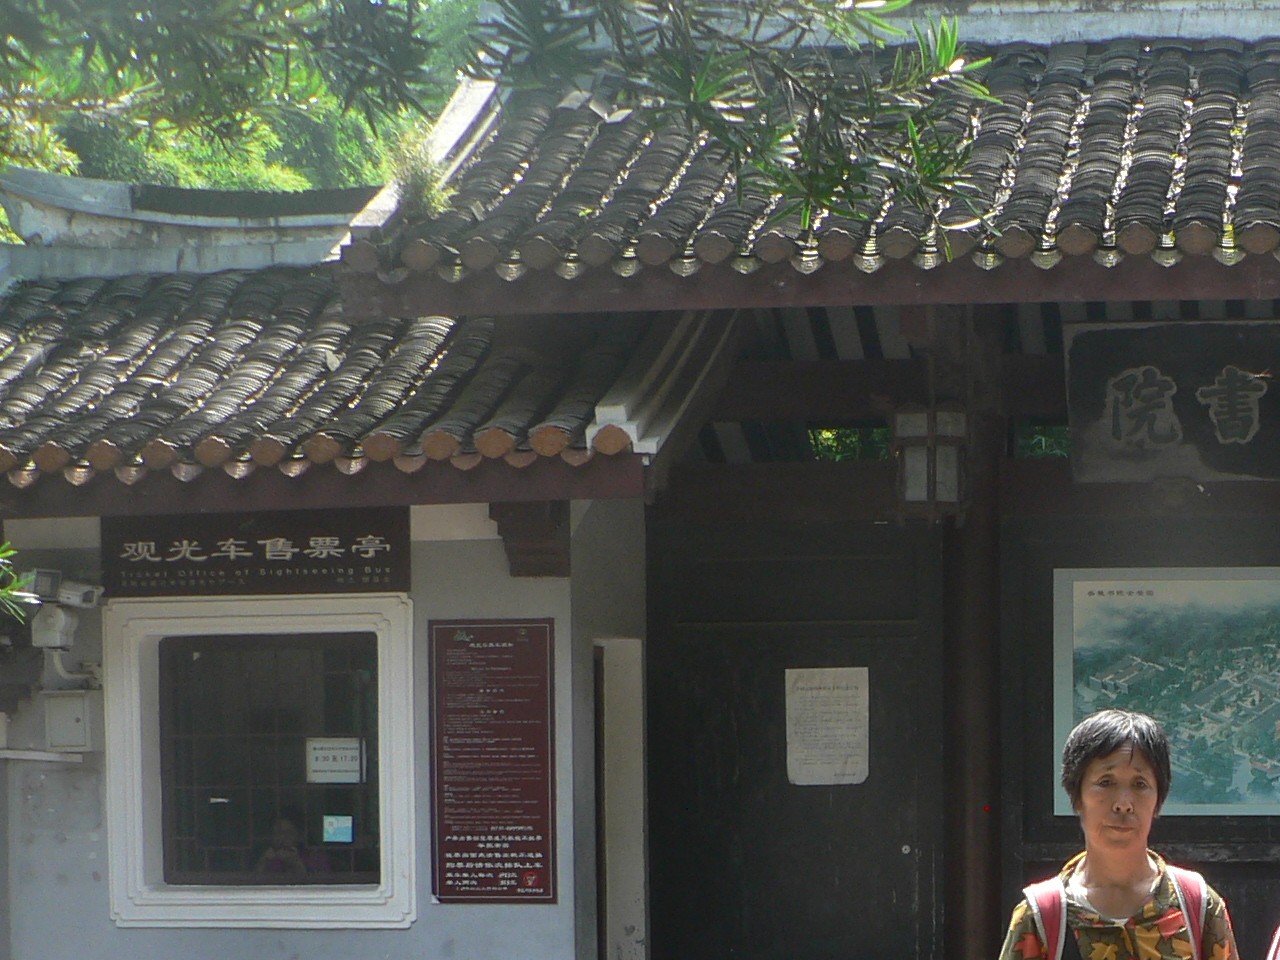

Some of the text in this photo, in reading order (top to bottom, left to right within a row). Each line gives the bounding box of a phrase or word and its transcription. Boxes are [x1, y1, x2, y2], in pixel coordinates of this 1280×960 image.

[120, 534, 391, 562] 观光车售票亭
[120, 565, 391, 578] Ticket Office of Sightseeing Bus
